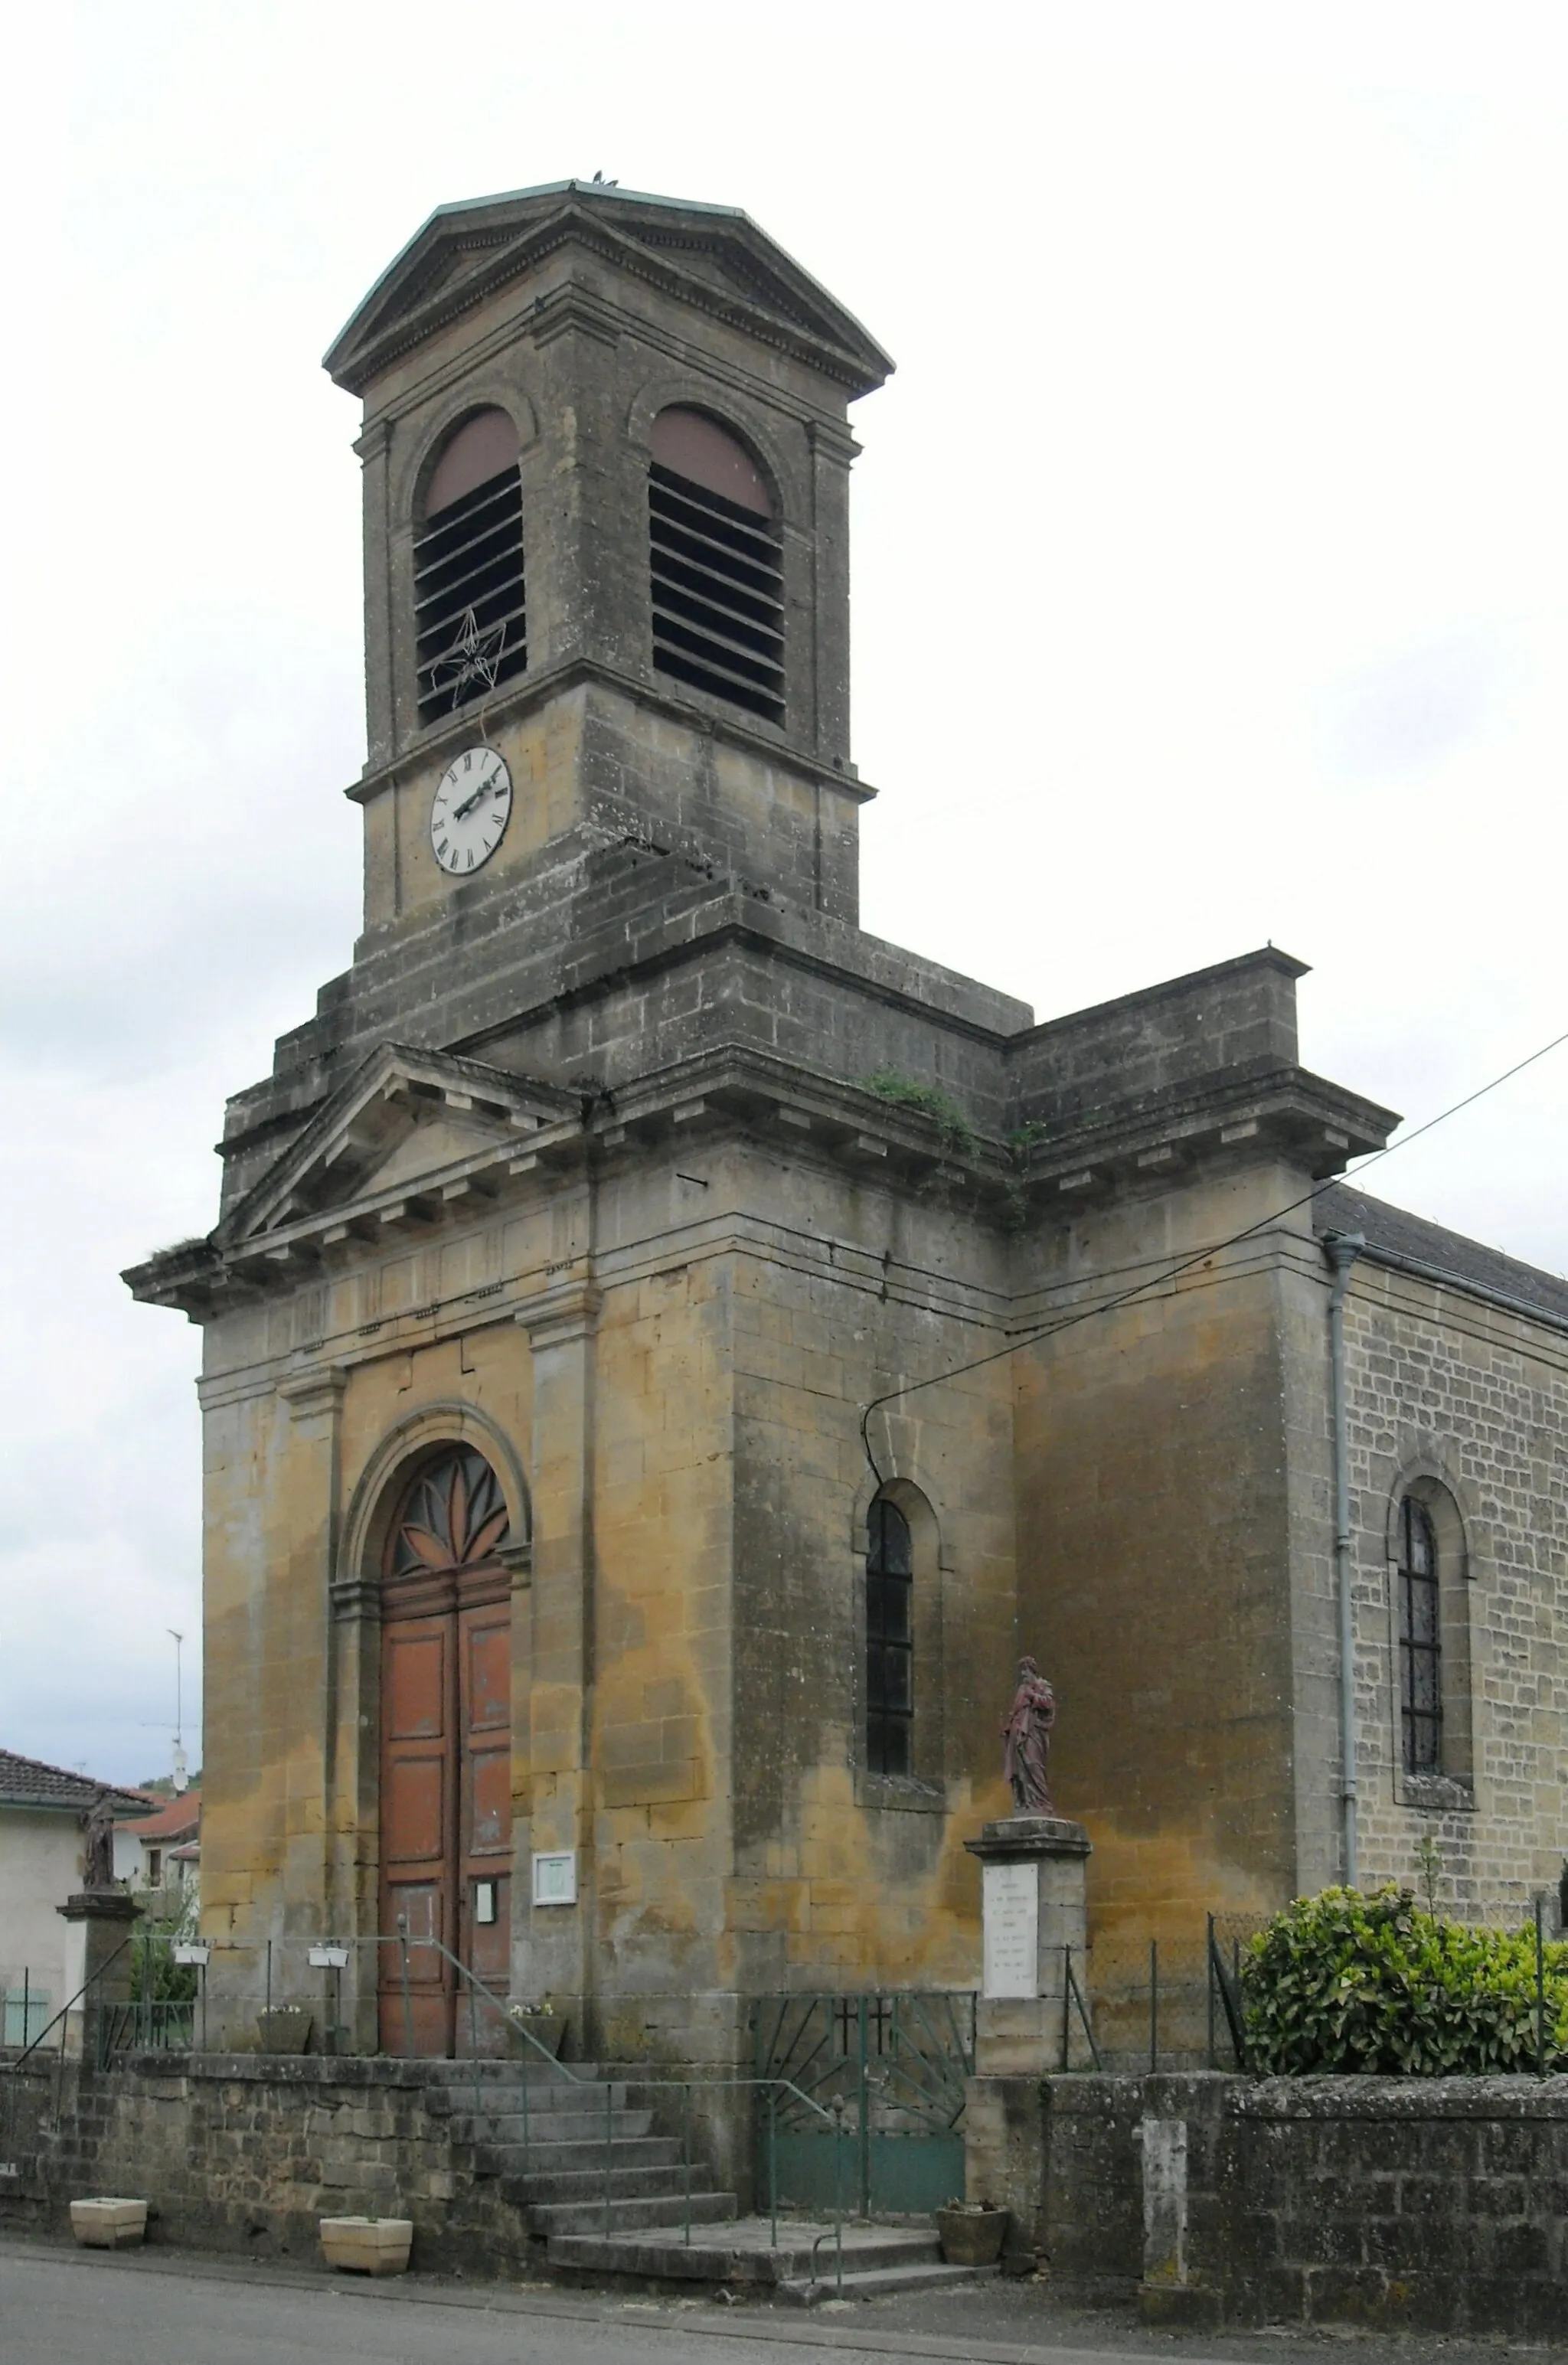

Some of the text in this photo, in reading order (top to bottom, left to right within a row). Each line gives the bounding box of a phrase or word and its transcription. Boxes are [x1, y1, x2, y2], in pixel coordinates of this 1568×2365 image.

[481, 750, 488, 770] I
[436, 795, 448, 805] X
[482, 837, 492, 852] V
